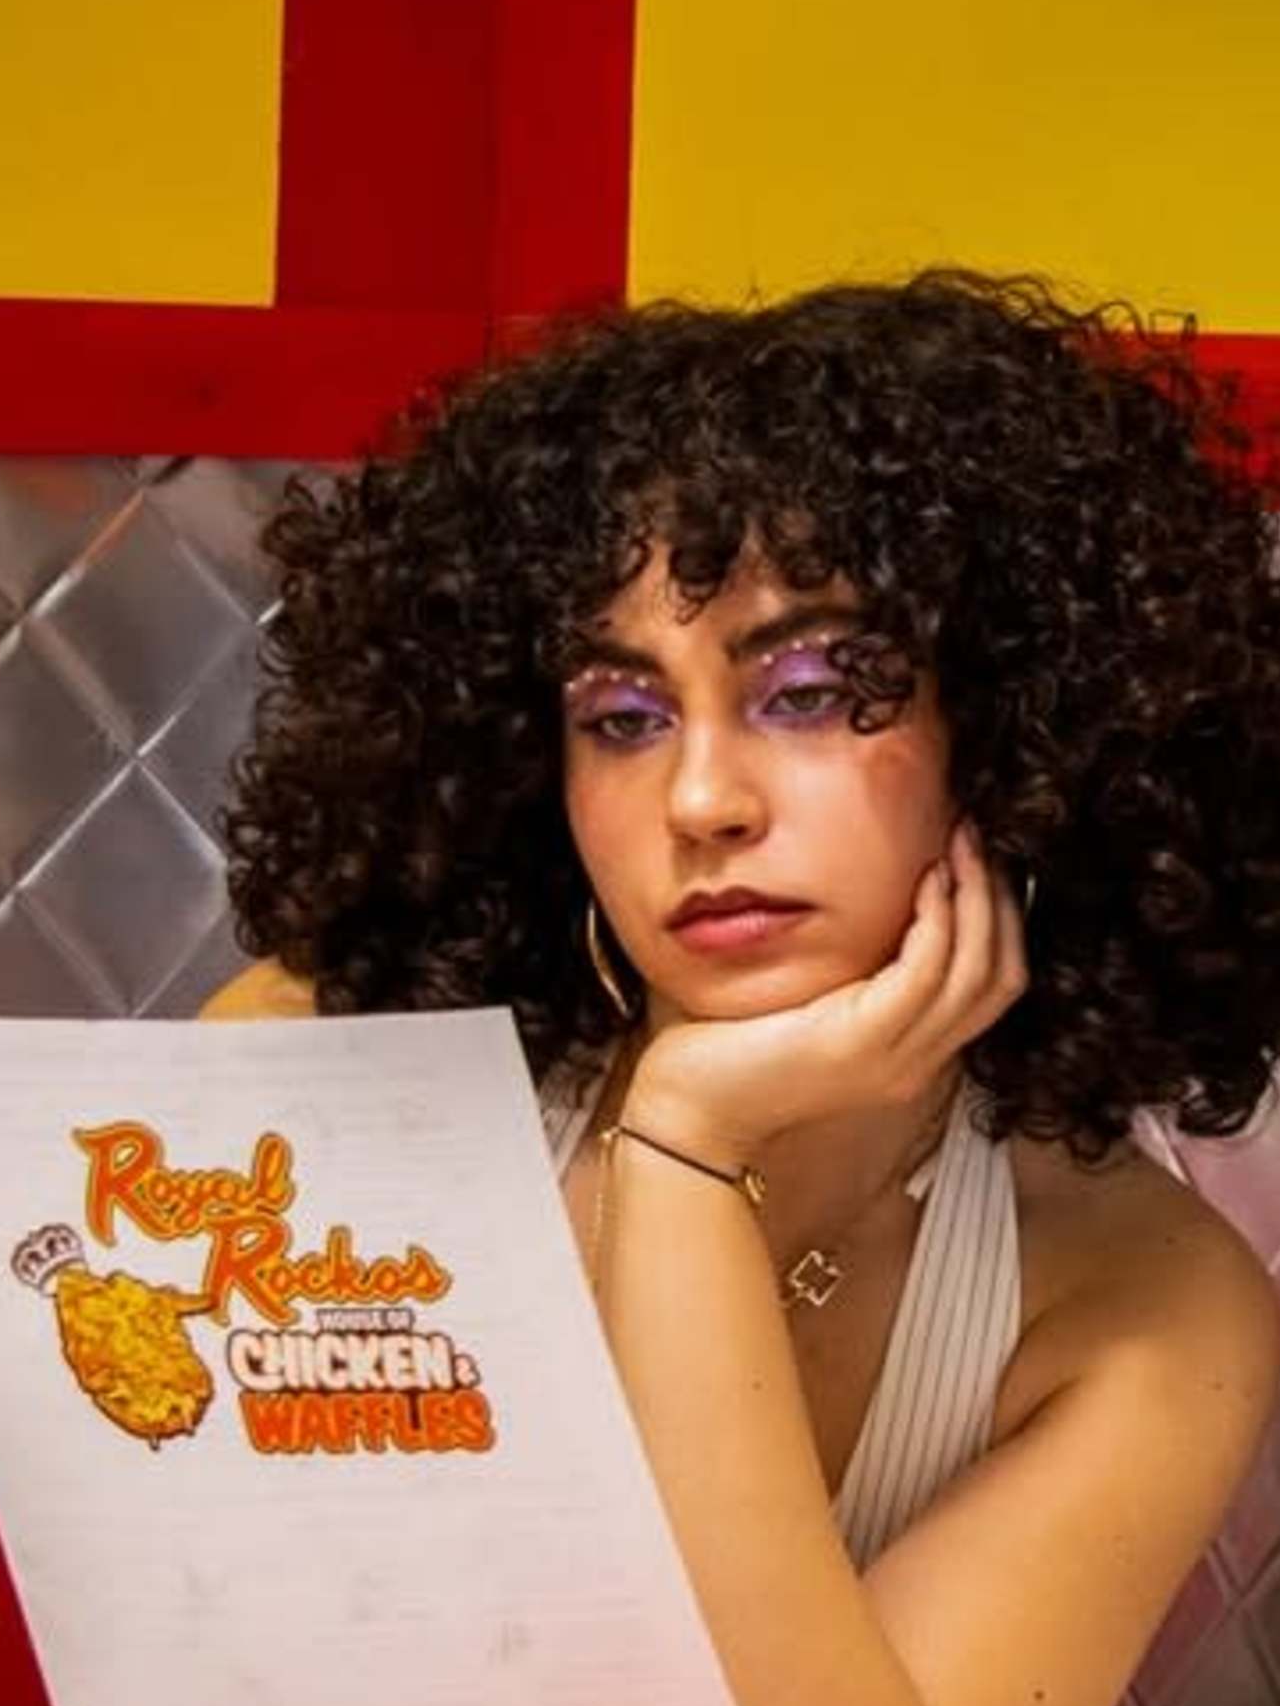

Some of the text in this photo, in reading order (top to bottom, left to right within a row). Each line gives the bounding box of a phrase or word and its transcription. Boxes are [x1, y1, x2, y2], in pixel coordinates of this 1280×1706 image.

[72, 1119, 298, 1247] Royal
[198, 1208, 454, 1328] Rockos
[227, 1329, 456, 1391] CHICKEN
[239, 1391, 497, 1454] WAFFLES
